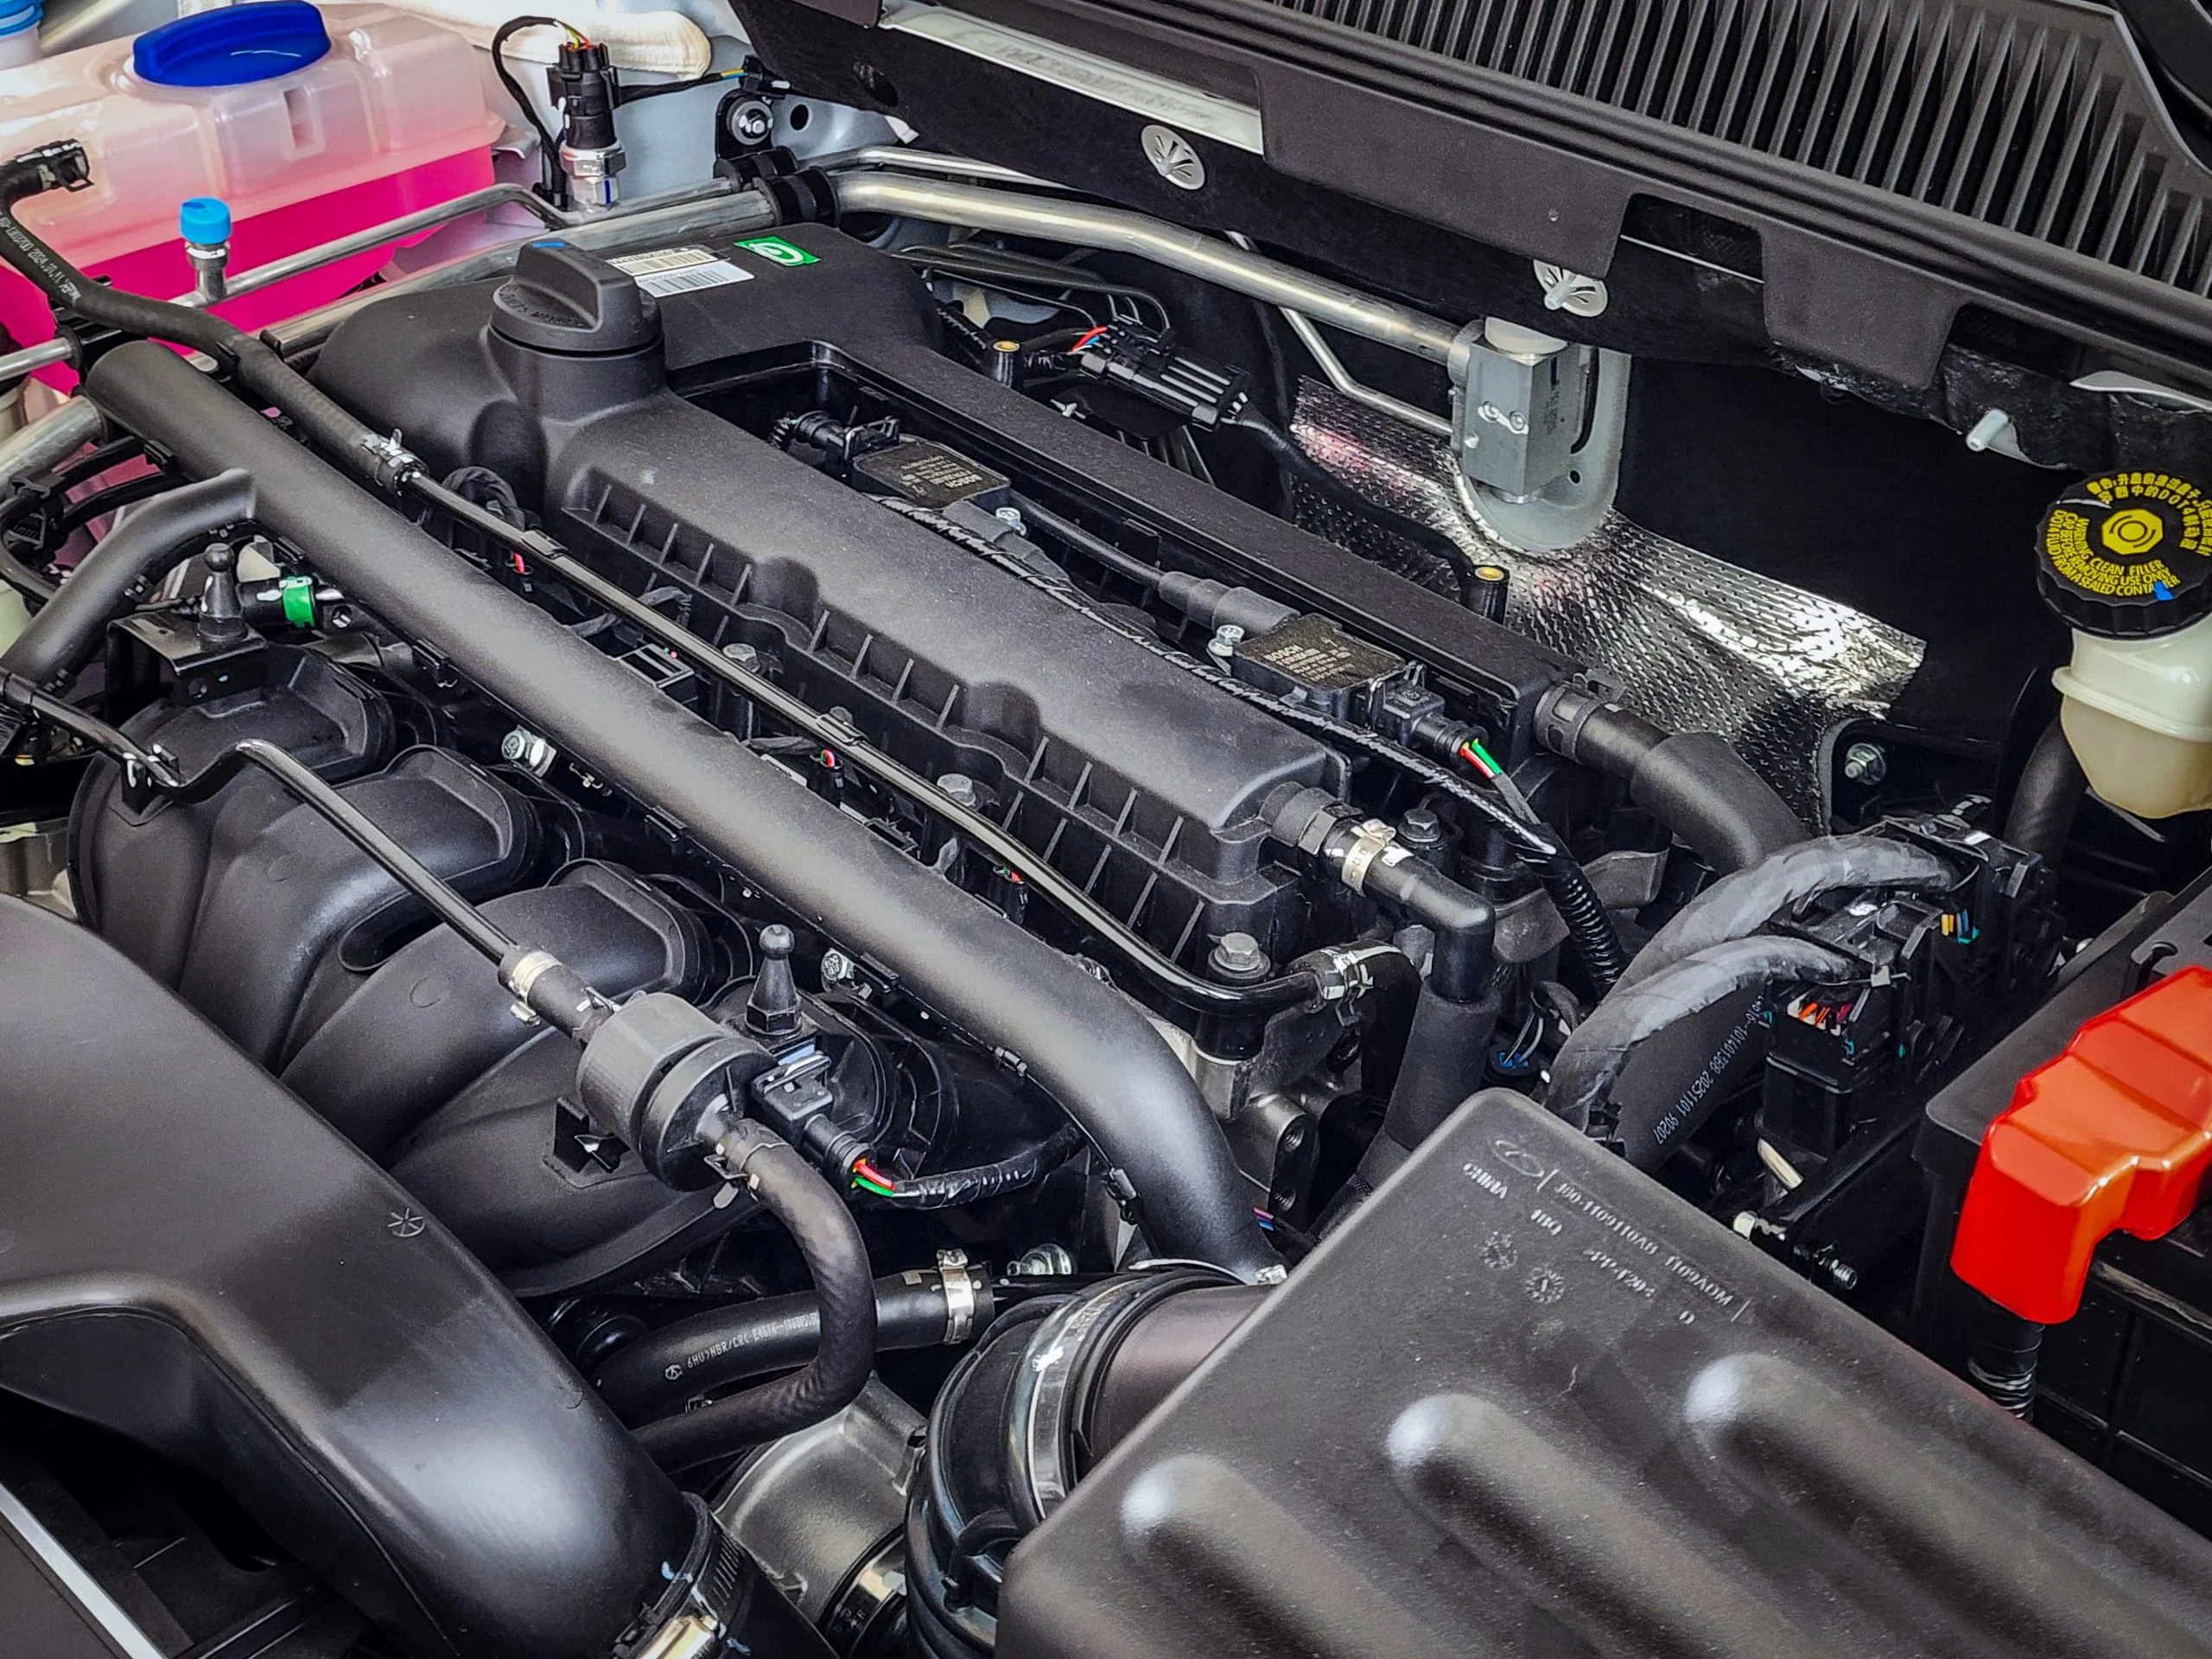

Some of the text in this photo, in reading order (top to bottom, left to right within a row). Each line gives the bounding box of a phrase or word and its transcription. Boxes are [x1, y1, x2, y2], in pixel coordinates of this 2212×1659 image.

[2046, 533, 2063, 556] FLUID
[2060, 512, 2171, 586] CAP BEFORE REMOVING USE ONLY
[2074, 518, 2165, 576] WARNING CLEAN FILLER
[2051, 555, 2076, 579] FROM
[2078, 575, 2117, 594] SEALED
[1262, 644, 1304, 662] BOSCH
[1675, 1071, 1714, 1117] 20251101
[1652, 1111, 1680, 1145] 90207
[1463, 1163, 1508, 1199] CHINA
